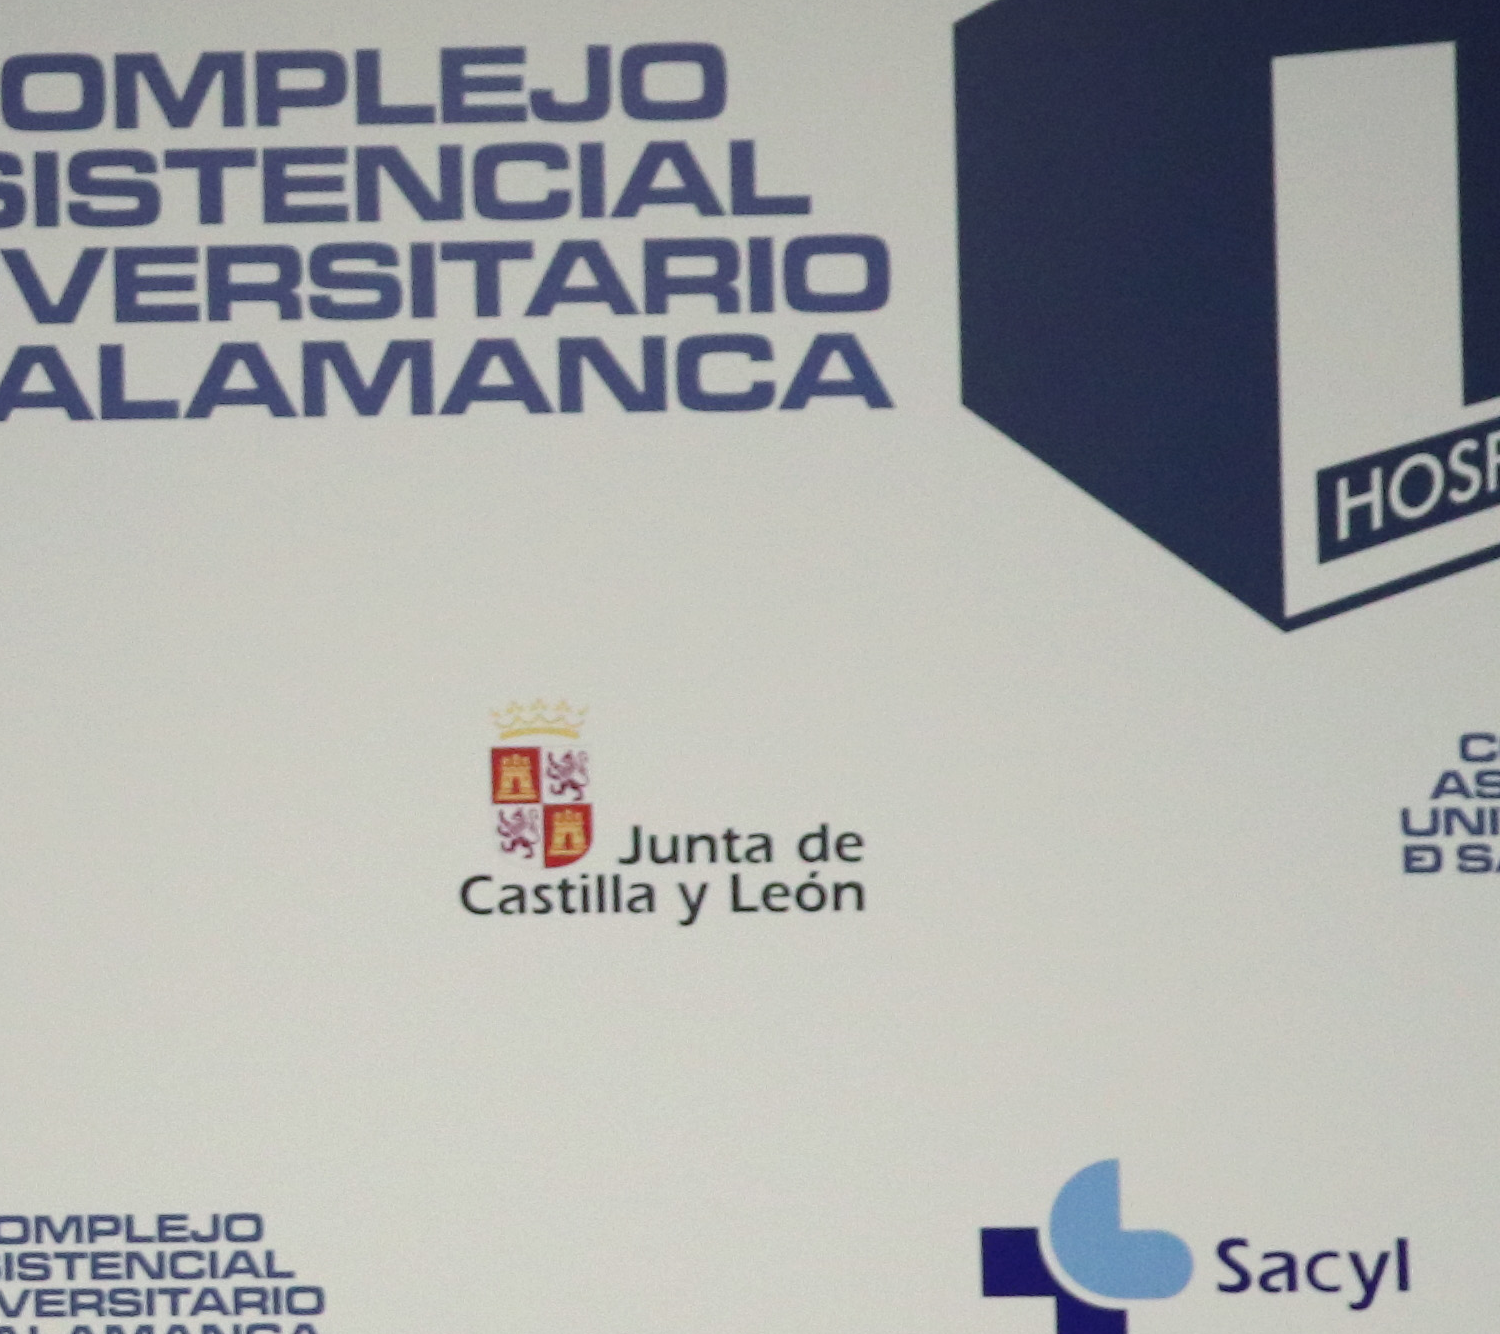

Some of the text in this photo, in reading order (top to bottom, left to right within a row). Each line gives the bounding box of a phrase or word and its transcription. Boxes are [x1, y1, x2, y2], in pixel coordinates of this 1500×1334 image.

[619, 824, 863, 865] Junta de
[460, 871, 864, 926] Castilla y León
[1217, 1238, 1409, 1311] Sacyl
